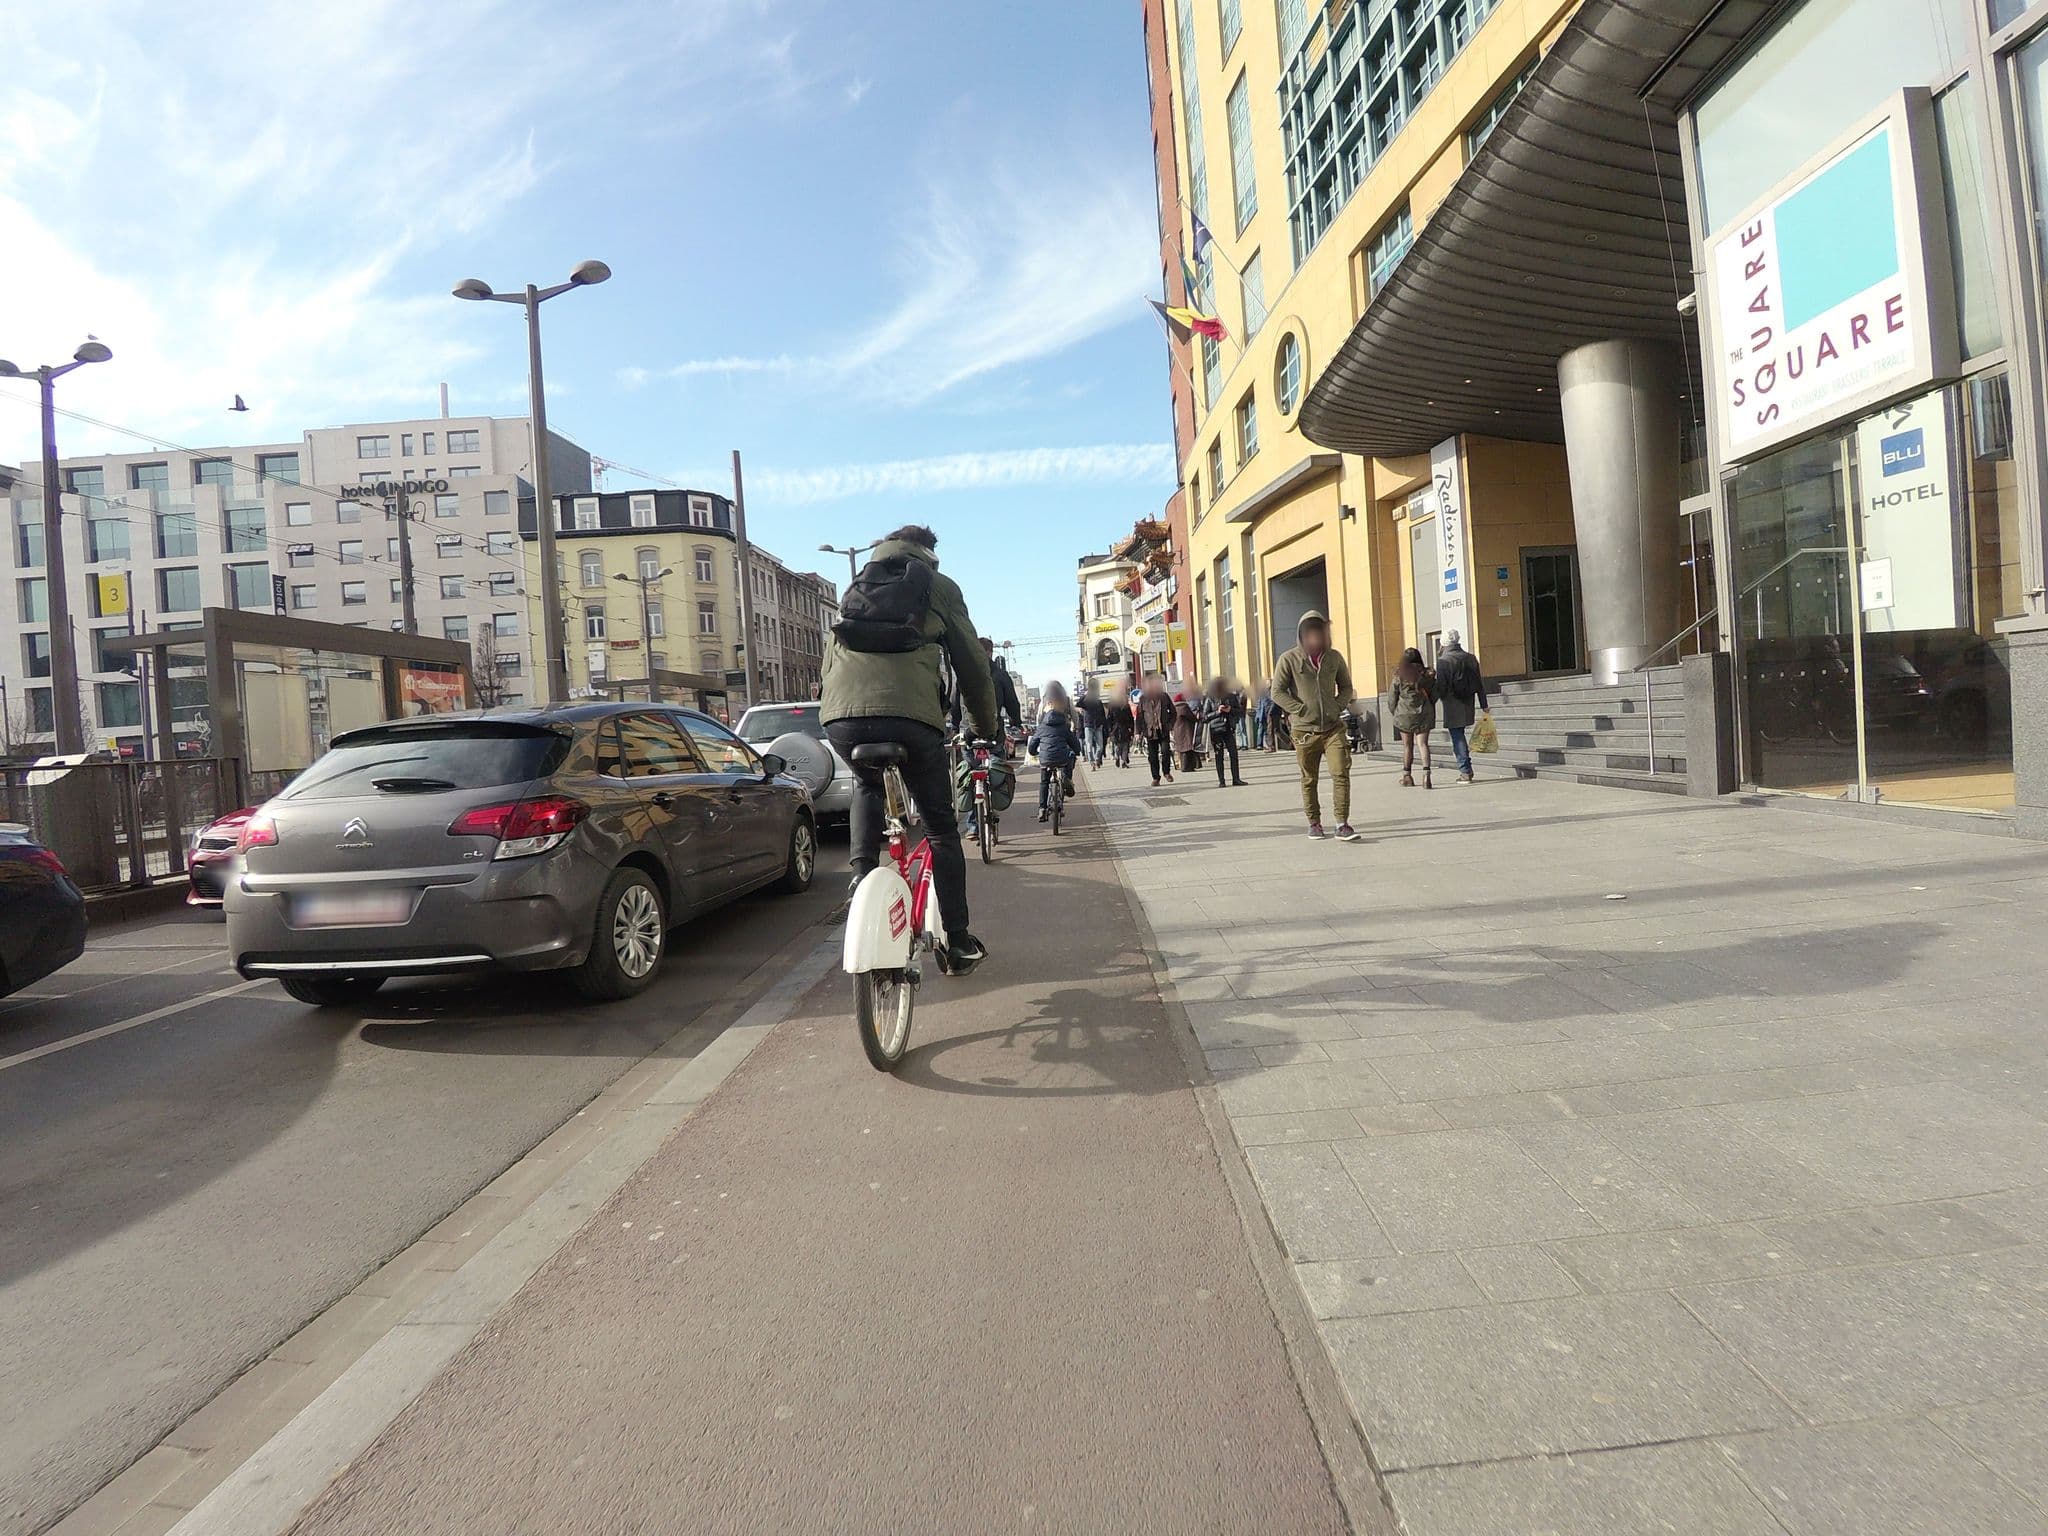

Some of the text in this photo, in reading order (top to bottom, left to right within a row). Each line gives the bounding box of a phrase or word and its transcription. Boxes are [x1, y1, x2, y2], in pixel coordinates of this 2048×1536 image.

[1740, 218, 1780, 426] SQUARE
[1730, 347, 1744, 364] THE
[1733, 293, 1904, 407] SQUARE
[1883, 444, 1921, 464] BLU
[341, 480, 449, 498] hotel INDIGO
[1871, 482, 1944, 511] HOTEL
[1435, 467, 1458, 567] Radisson
[110, 587, 119, 602] 3
[274, 580, 285, 607] hotel
[1441, 598, 1464, 610] HOTEL
[1176, 636, 1182, 644] 5
